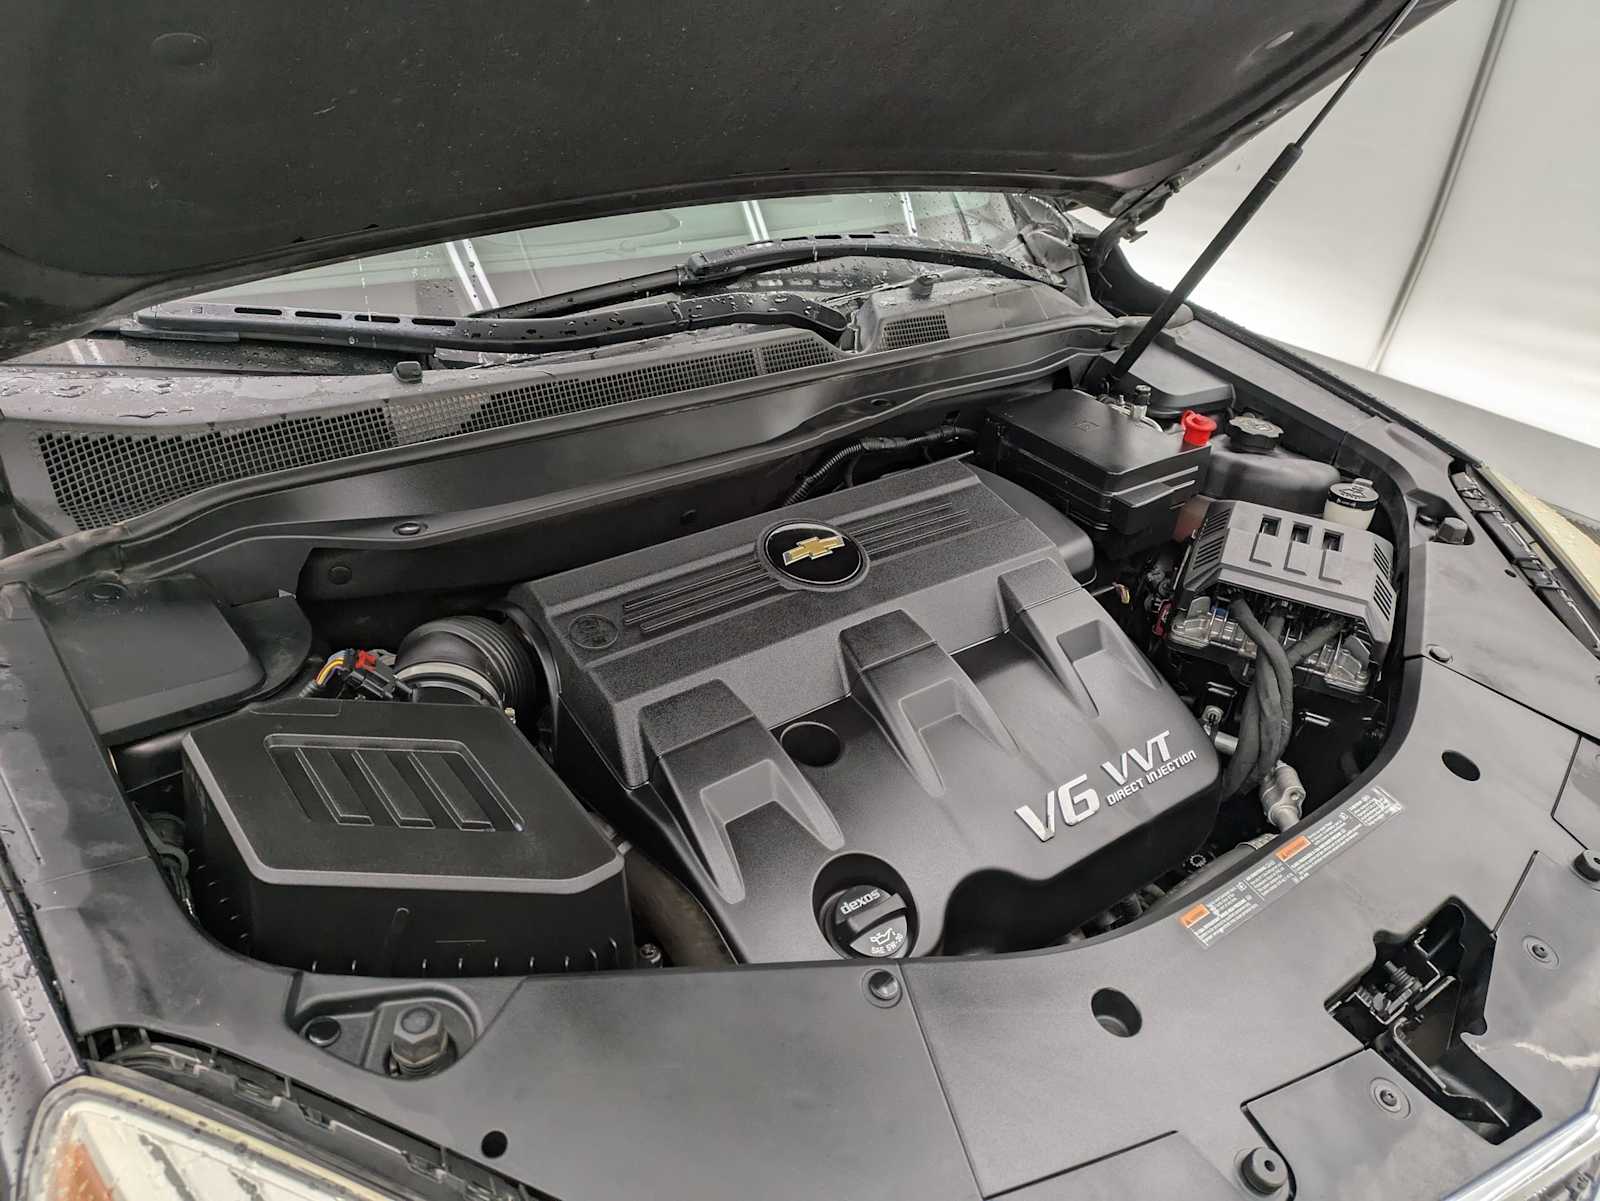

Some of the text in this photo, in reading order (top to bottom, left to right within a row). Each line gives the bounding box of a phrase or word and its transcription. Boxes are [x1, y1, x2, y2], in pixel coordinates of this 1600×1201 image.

[1015, 729, 1171, 842] V6 VVT
[1105, 750, 1198, 806] DIRECT INJECTION
[840, 888, 881, 915] dexos
